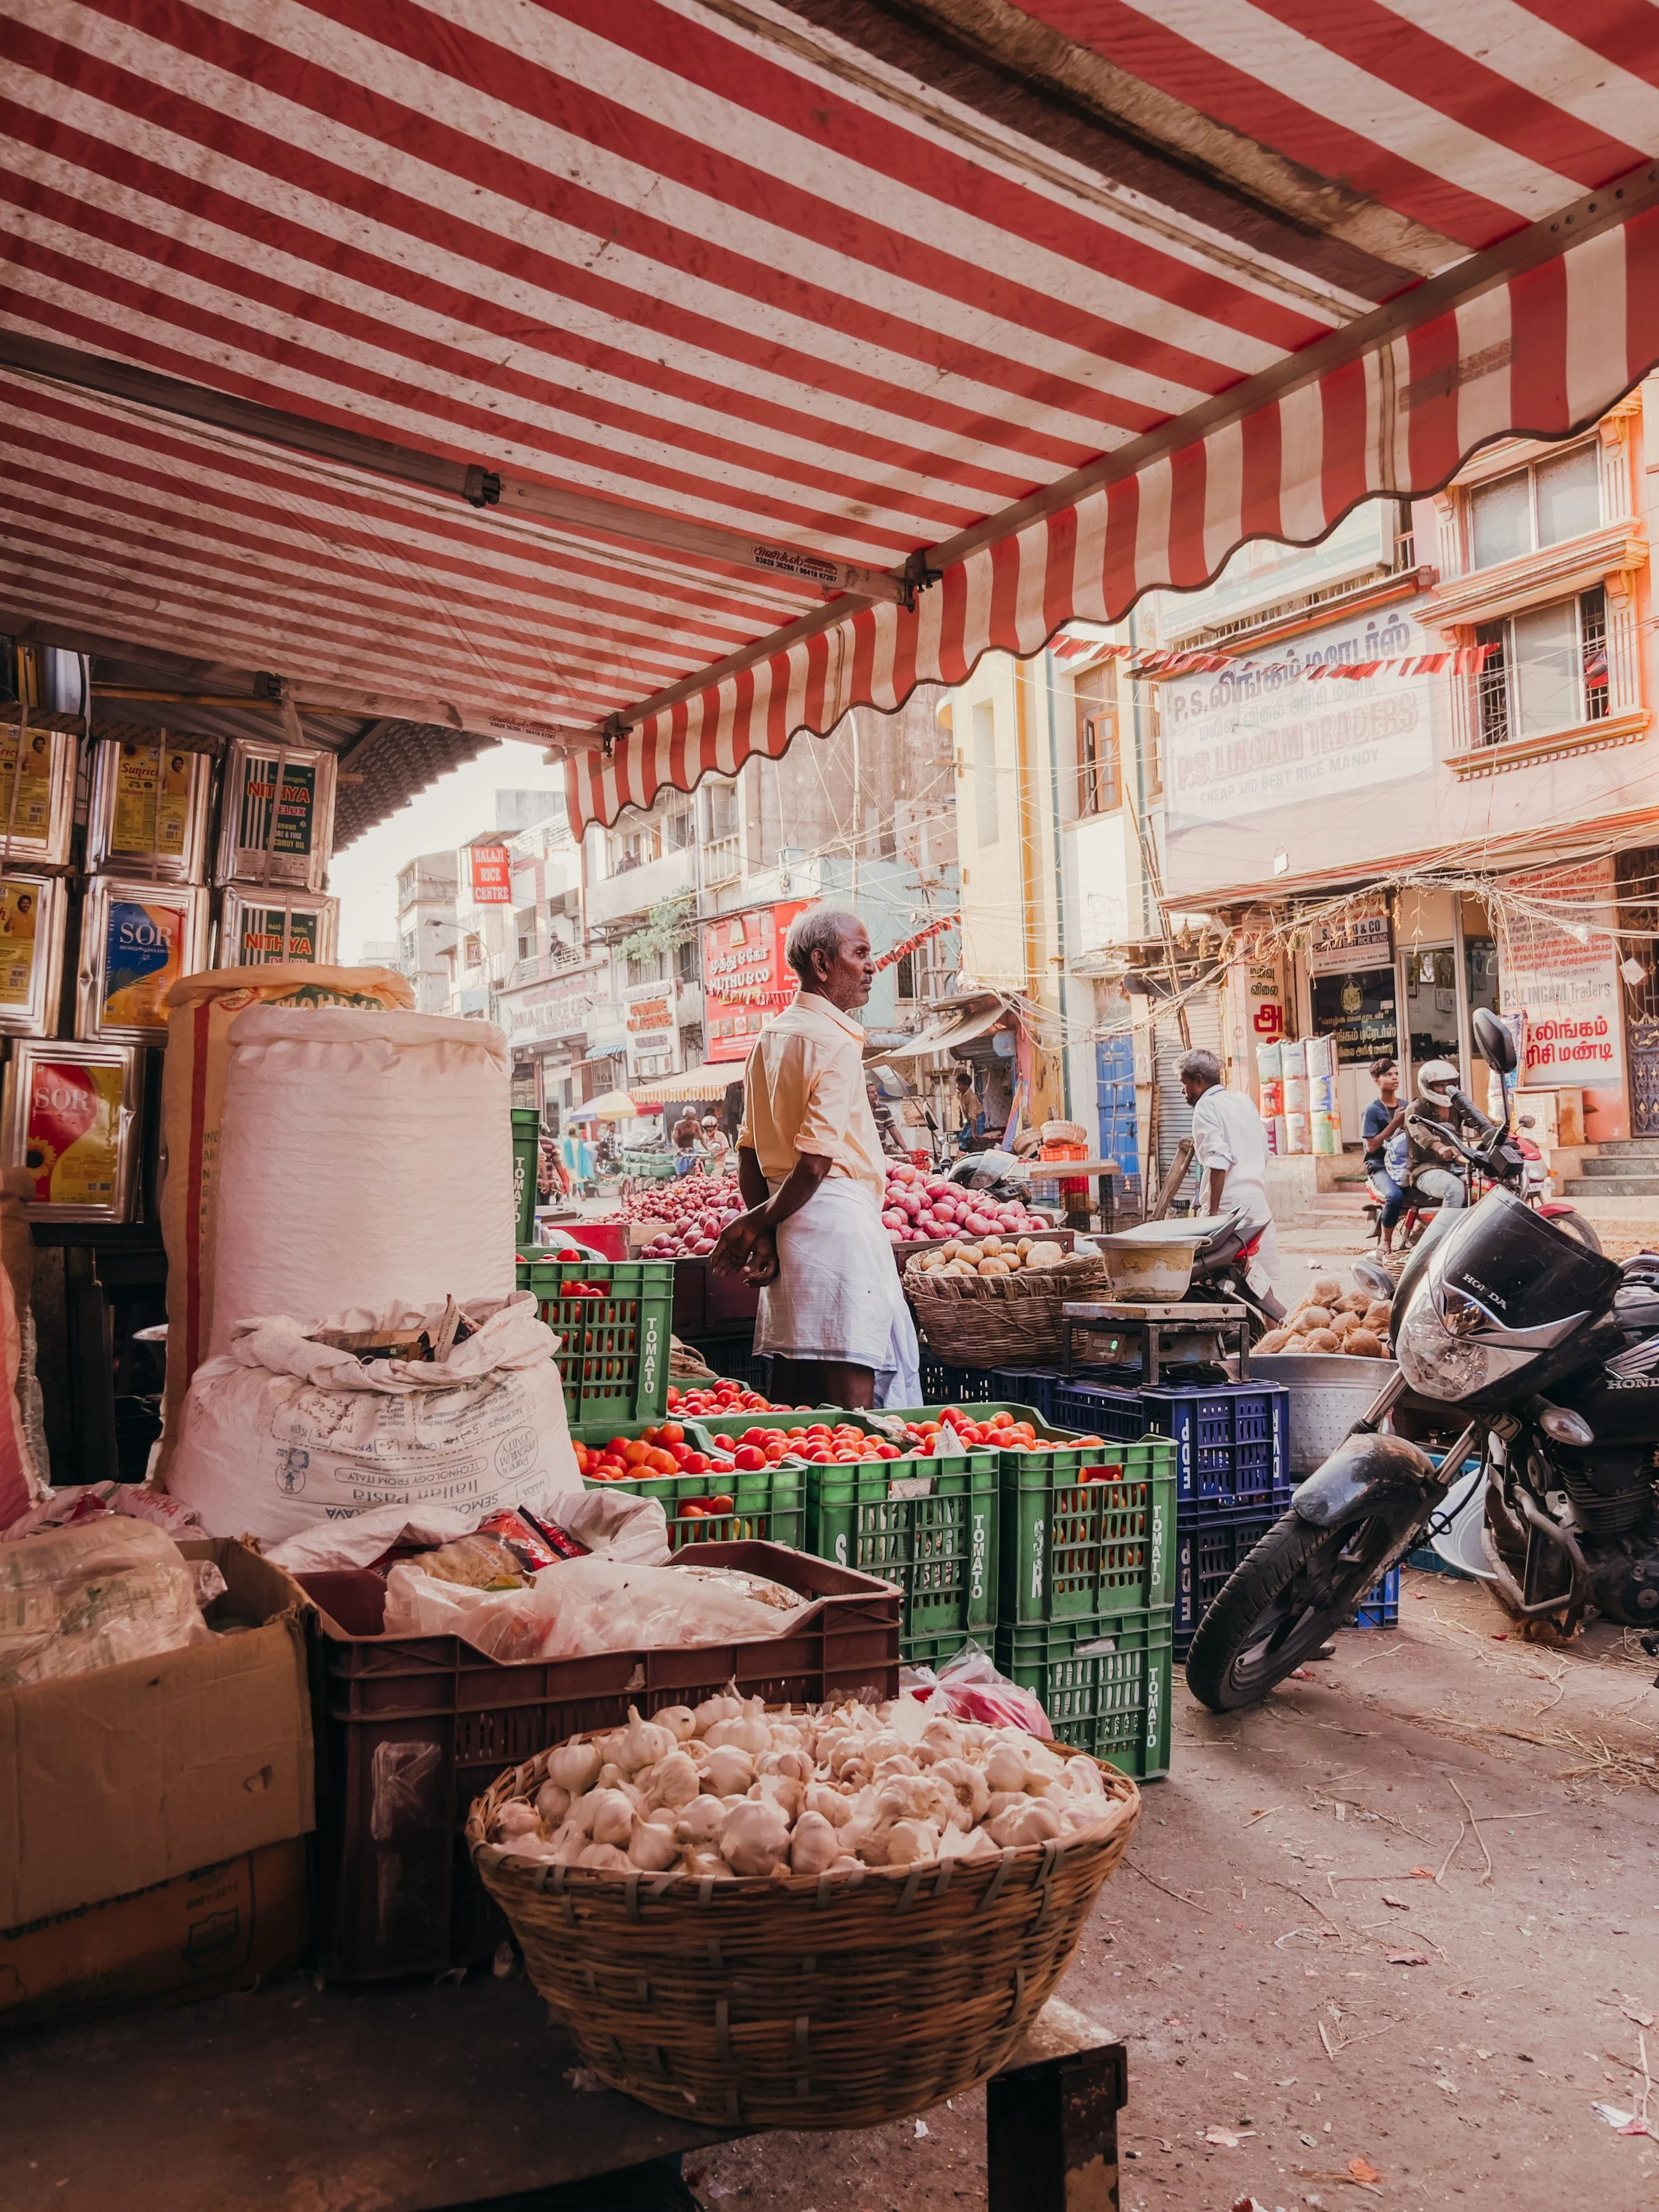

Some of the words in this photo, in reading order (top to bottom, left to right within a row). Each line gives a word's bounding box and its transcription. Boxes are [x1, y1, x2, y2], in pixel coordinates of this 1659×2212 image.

[1307, 692, 1419, 756] TRADERS
[1200, 784, 1234, 805] CHEAP
[1240, 779, 1258, 796] AND
[1262, 769, 1291, 790] BEST
[1296, 761, 1324, 781] RICE
[1329, 747, 1380, 774] MANDY
[270, 804, 307, 817] ELUX
[475, 849, 504, 863] BALAJI
[480, 867, 501, 881] RICE
[476, 886, 509, 900] CENTRE
[120, 922, 173, 947] SOR
[1360, 924, 1366, 934] &
[1368, 920, 1380, 932] CO
[1358, 936, 1371, 944] RICE
[1570, 980, 1611, 999] Traders
[545, 999, 569, 1023] RICE
[1526, 1043, 1555, 1070] ரிசி
[1559, 1041, 1613, 1061] மண்டி
[35, 1087, 90, 1111] SOR
[644, 1317, 658, 1394] TOMATO
[1606, 1377, 1659, 1390] HOND
[500, 1439, 535, 1466] PREMIUM
[347, 1473, 375, 1484] ITALY
[378, 1477, 409, 1486] FROM
[413, 1461, 480, 1486] TECHNOLOGY
[353, 1489, 409, 1505] Pasta
[418, 1479, 478, 1501] Italian
[522, 1479, 545, 1497] MAIDA
[970, 1514, 985, 1599] TOMATO
[1151, 1505, 1163, 1586] TOMATO
[1147, 1667, 1161, 1747] TOMATO
